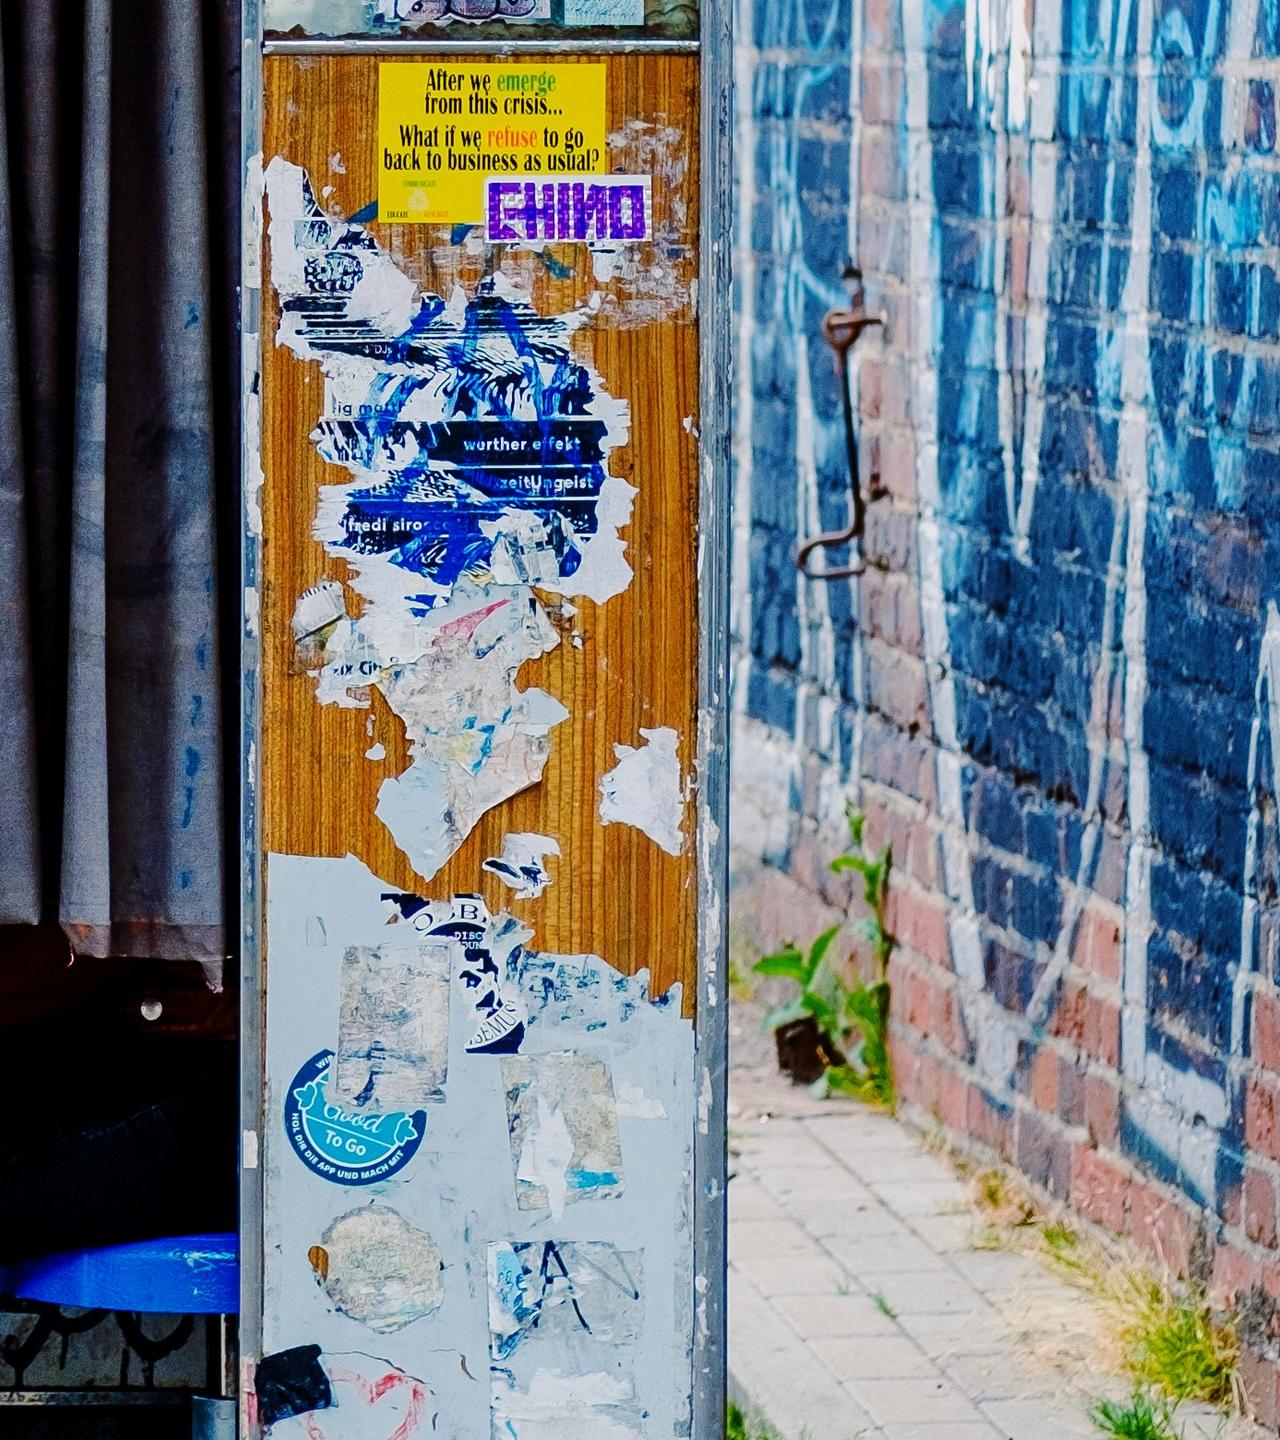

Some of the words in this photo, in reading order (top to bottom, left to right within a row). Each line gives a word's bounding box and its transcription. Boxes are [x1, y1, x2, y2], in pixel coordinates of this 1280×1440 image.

[426, 69, 465, 92] After
[470, 75, 491, 91] we
[497, 74, 556, 95] emerge
[425, 93, 462, 115] from
[469, 92, 498, 114] this
[504, 92, 563, 115] crisis...
[400, 125, 438, 148] What
[445, 124, 456, 147] if
[461, 131, 482, 148] we
[487, 125, 538, 148] refuse
[543, 129, 559, 148] to
[565, 129, 584, 152] go
[384, 148, 421, 170] back
[427, 151, 441, 170] to
[448, 146, 518, 171] business
[524, 153, 541, 171] as
[547, 148, 599, 172] usual?
[292, 1112, 300, 1132] HOL
[295, 1134, 308, 1152] DIR
[325, 1131, 342, 1146] To
[345, 1138, 367, 1156] Go
[304, 1149, 318, 1165] DIE
[388, 1151, 404, 1166] MIT
[317, 1160, 336, 1176] APP
[338, 1171, 358, 1180] UND
[361, 1163, 389, 1179] MACH
